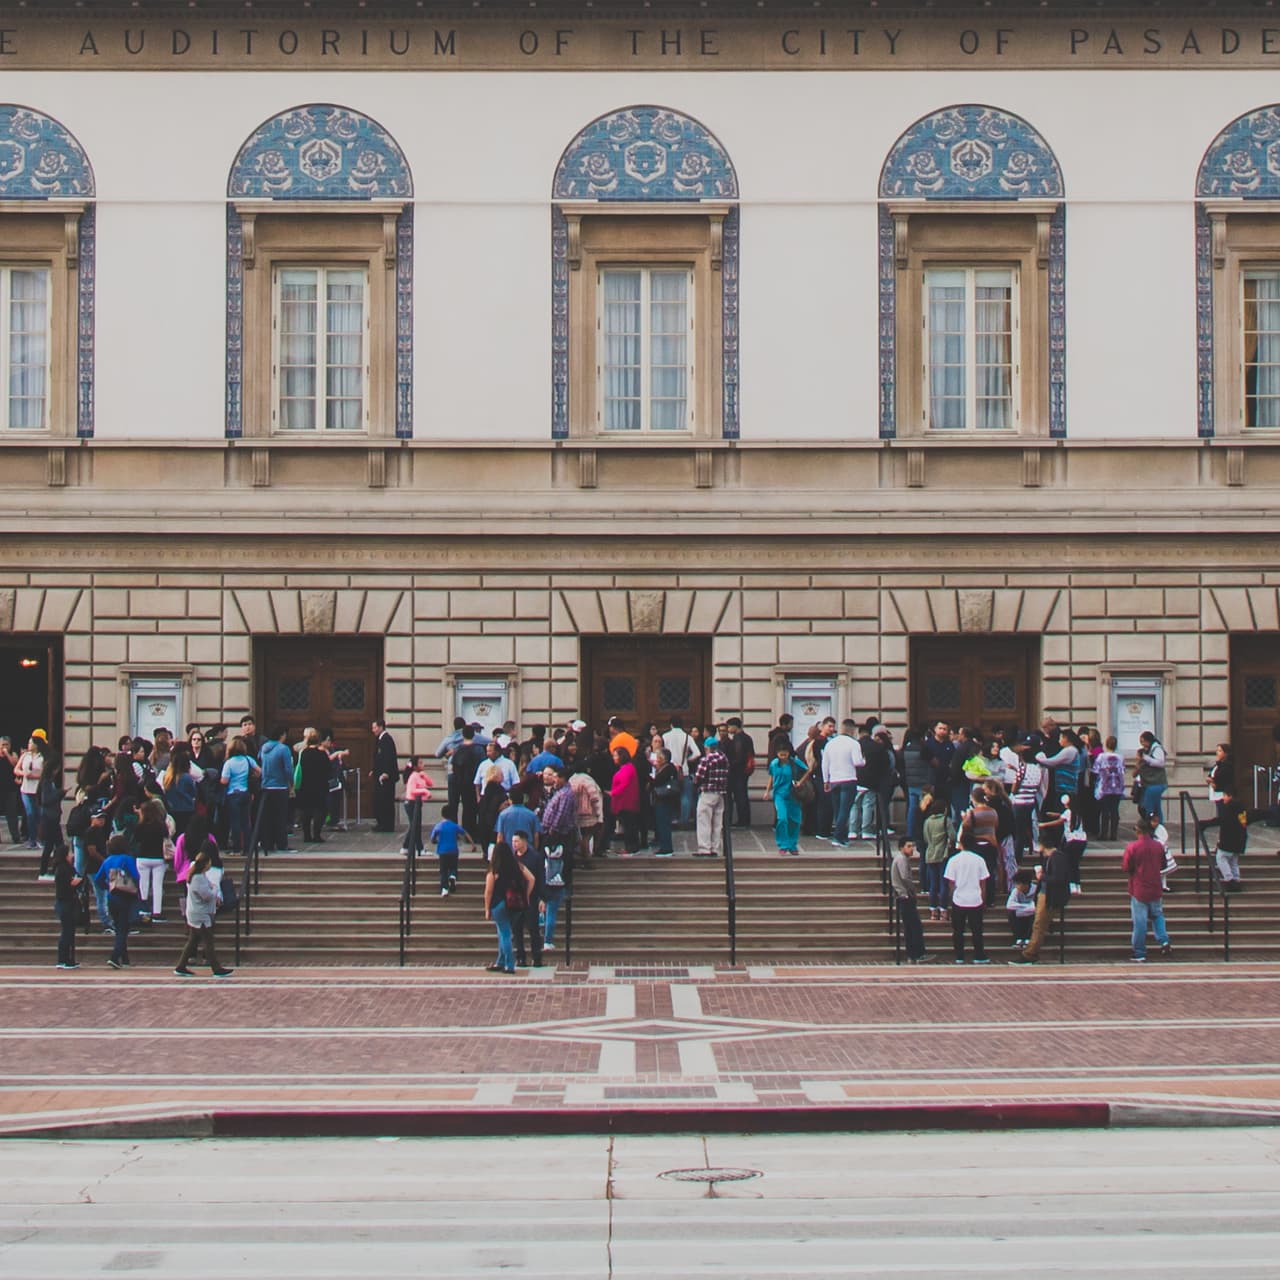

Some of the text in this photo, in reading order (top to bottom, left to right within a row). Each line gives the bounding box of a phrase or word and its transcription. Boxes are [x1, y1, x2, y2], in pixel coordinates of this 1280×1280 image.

[80, 29, 456, 56] AUDITORIUM
[520, 30, 573, 56] OF
[626, 30, 720, 56] THE
[782, 29, 901, 56] CITY
[960, 29, 1013, 56] OF
